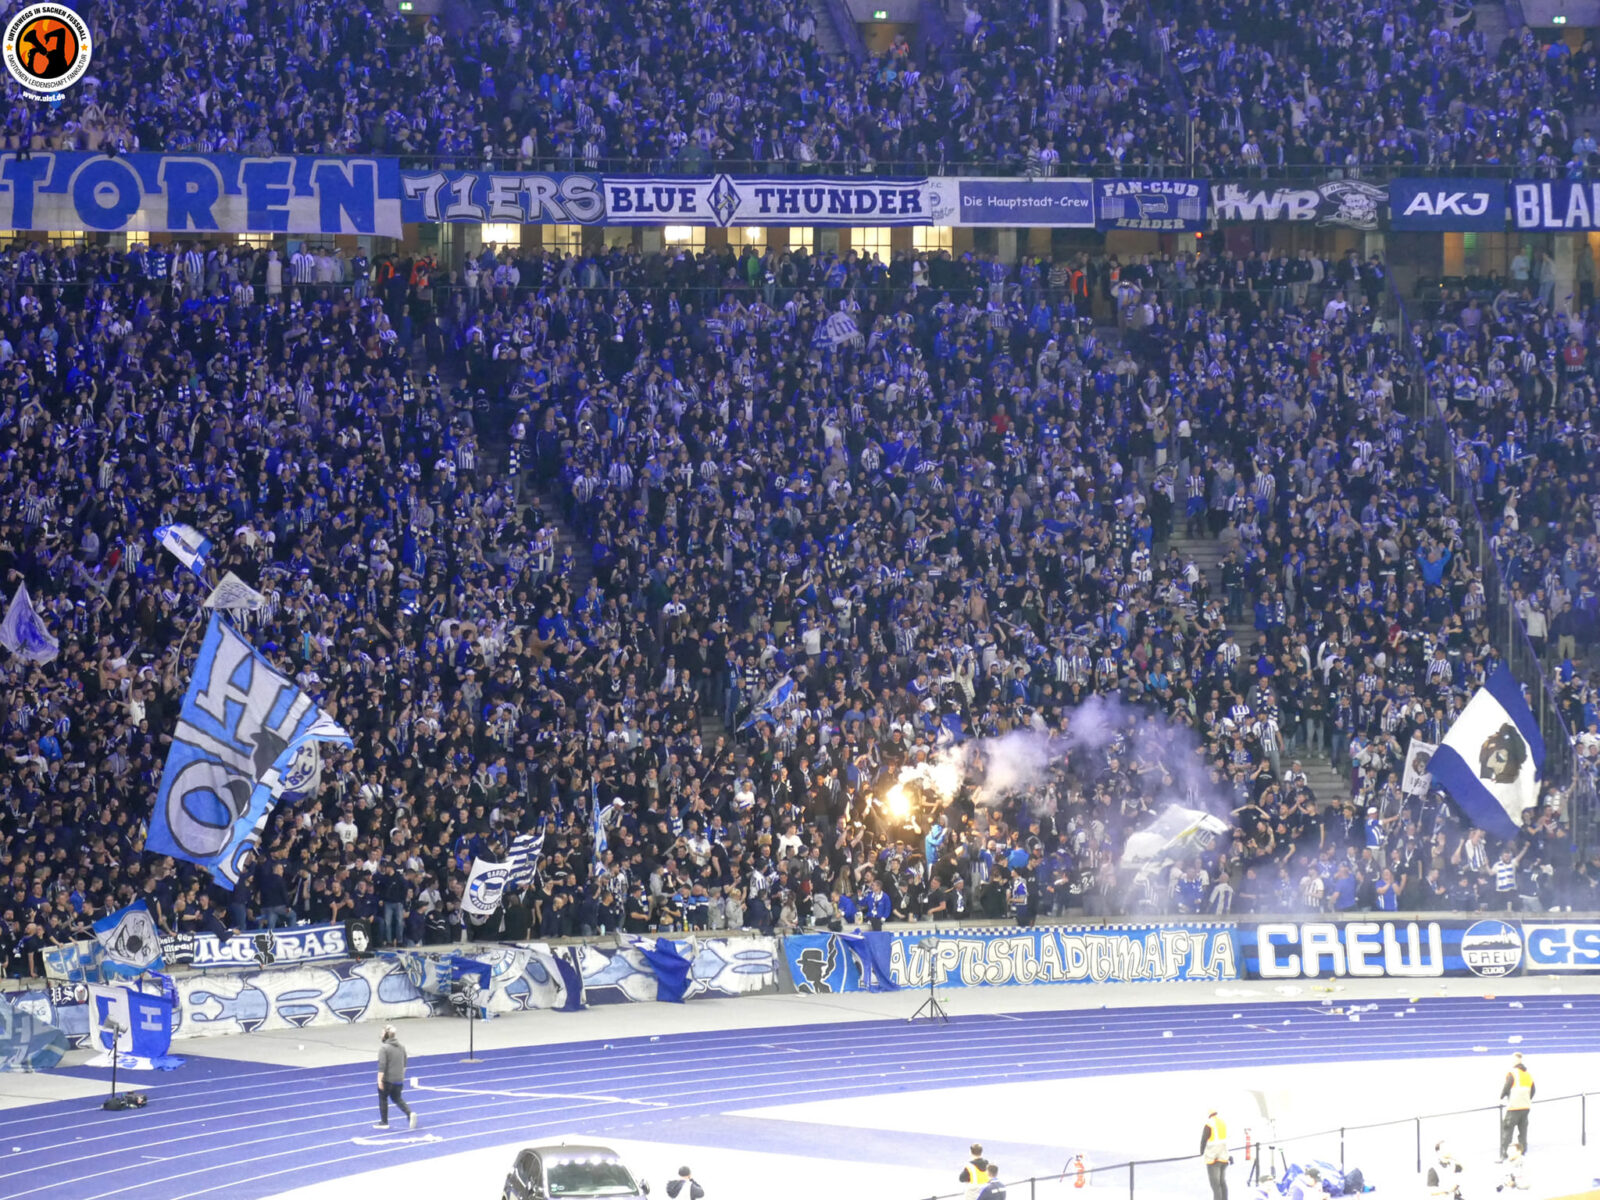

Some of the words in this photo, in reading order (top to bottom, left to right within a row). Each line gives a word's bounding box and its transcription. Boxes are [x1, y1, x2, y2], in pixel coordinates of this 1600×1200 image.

[403, 173, 604, 222] 71ERS
[611, 187, 696, 213] BLUE
[754, 187, 923, 214] THUNDER
[1103, 181, 1199, 197] FAN-CLUB
[963, 195, 983, 207] Die
[987, 194, 1090, 211] Hauptstadt-Crew
[1403, 192, 1489, 215] AKJ
[857, 930, 1238, 987] AUPTSTADTMAFIA
[1257, 922, 1444, 978] CREW
[1468, 951, 1517, 964] CREW
